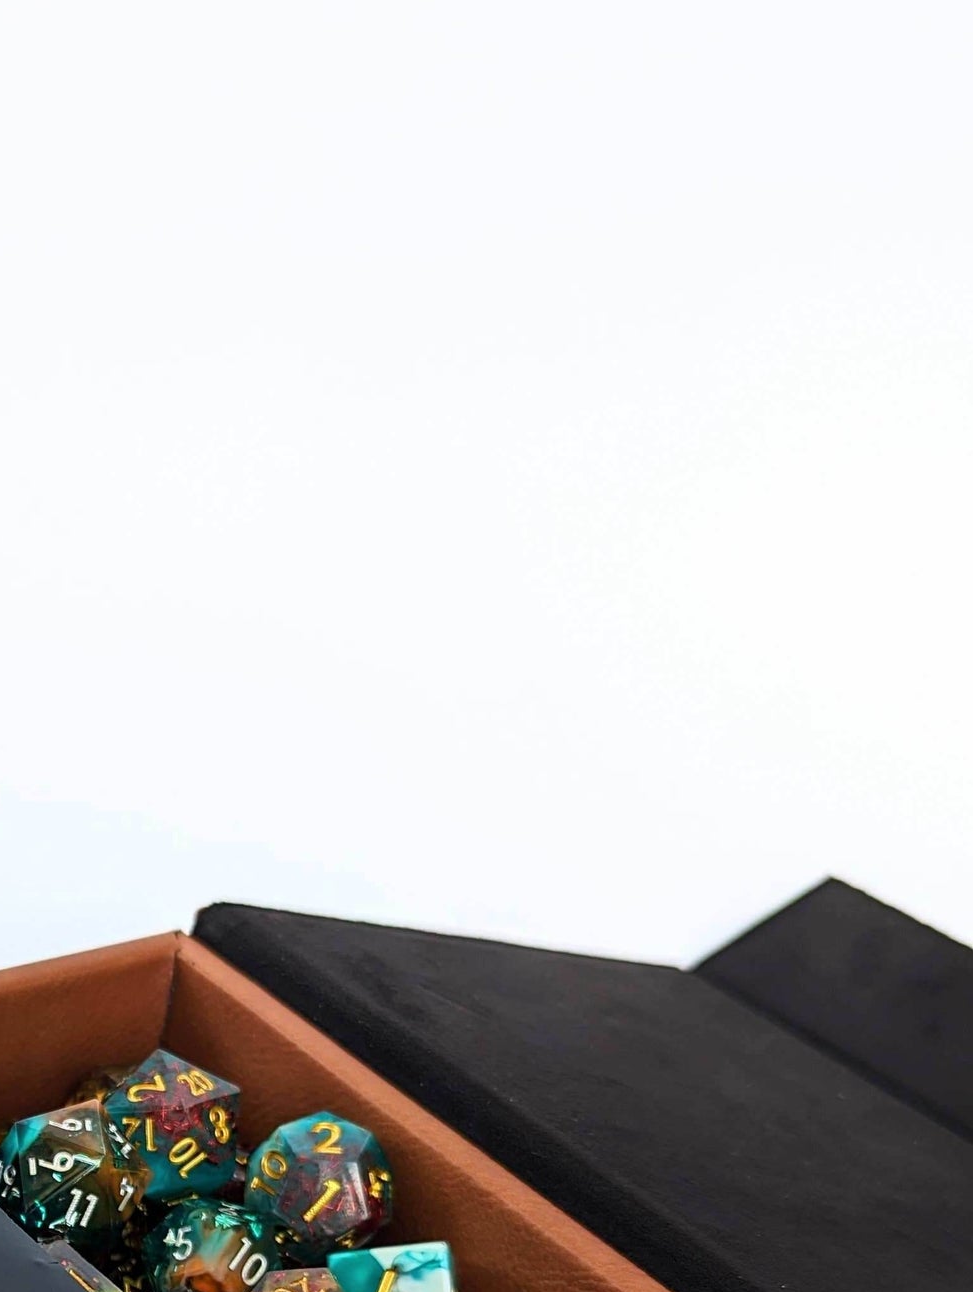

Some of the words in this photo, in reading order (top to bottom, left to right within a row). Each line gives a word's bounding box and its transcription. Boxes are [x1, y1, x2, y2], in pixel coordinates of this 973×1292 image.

[176, 1070, 215, 1096] 20
[209, 1106, 230, 1145] 8
[310, 1122, 344, 1154] 2
[168, 1136, 209, 1178] 10
[303, 1179, 343, 1223] 1
[227, 1237, 268, 1287] 10
